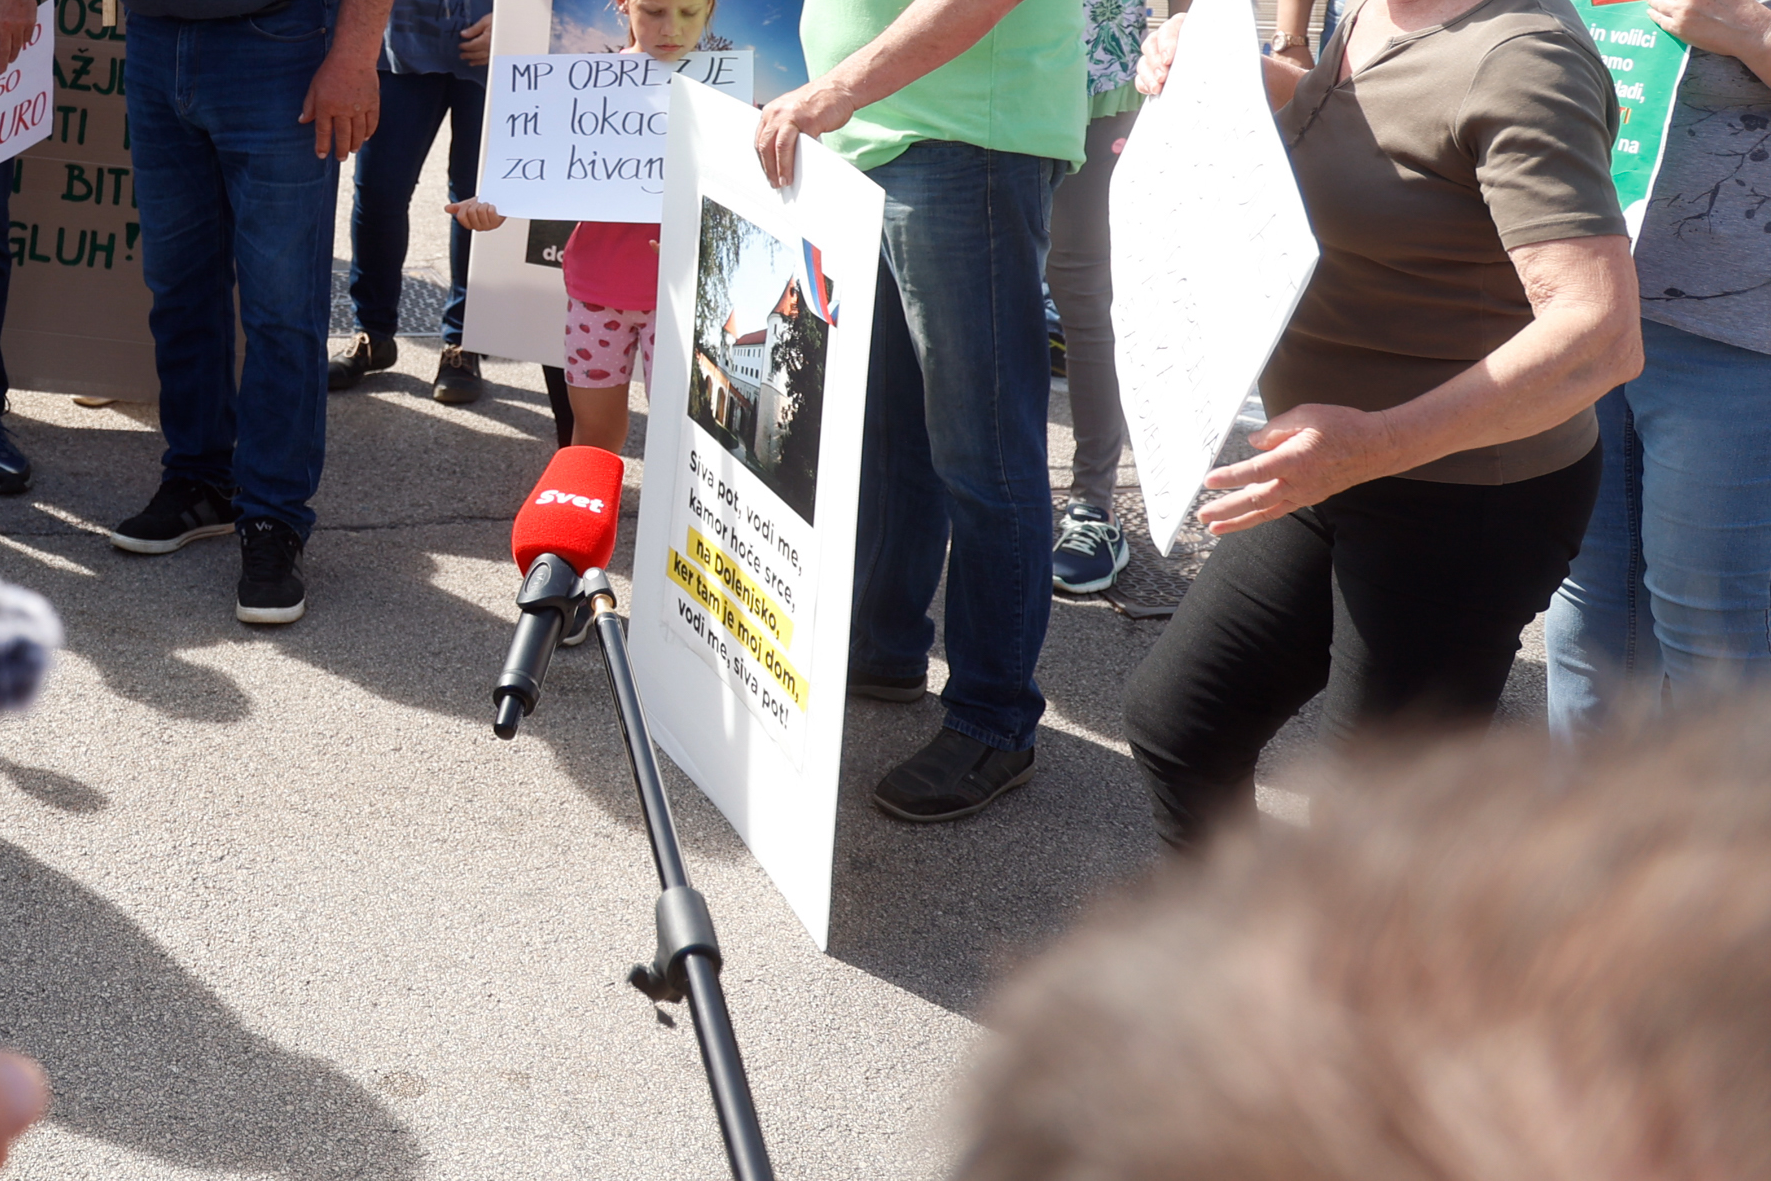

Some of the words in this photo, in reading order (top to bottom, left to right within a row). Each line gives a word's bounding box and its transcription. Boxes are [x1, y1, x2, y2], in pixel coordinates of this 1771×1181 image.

[1589, 23, 1607, 42] in
[1610, 28, 1658, 49] volilci
[512, 62, 554, 93] MP
[506, 105, 542, 138] ni
[570, 96, 668, 136] lokac
[501, 157, 547, 181] za
[567, 144, 665, 194] bivan
[1617, 137, 1640, 155] na
[535, 489, 605, 514] Svet
[689, 450, 714, 489] Siva
[717, 479, 742, 520] pot,
[746, 504, 774, 546] vodi
[778, 538, 802, 577] me,
[689, 486, 728, 541] kamor
[730, 527, 761, 572] hoče
[764, 564, 796, 613] srce,
[696, 538, 712, 566] na
[715, 552, 780, 641] Dolenjsko,
[673, 550, 694, 586] ker
[696, 574, 720, 612] tam
[722, 599, 735, 629] je
[737, 623, 762, 663] moj
[765, 647, 800, 703] dom,
[678, 597, 705, 639] vodi
[707, 632, 731, 670] me,
[733, 655, 758, 696] siva
[762, 684, 790, 731] pot!
